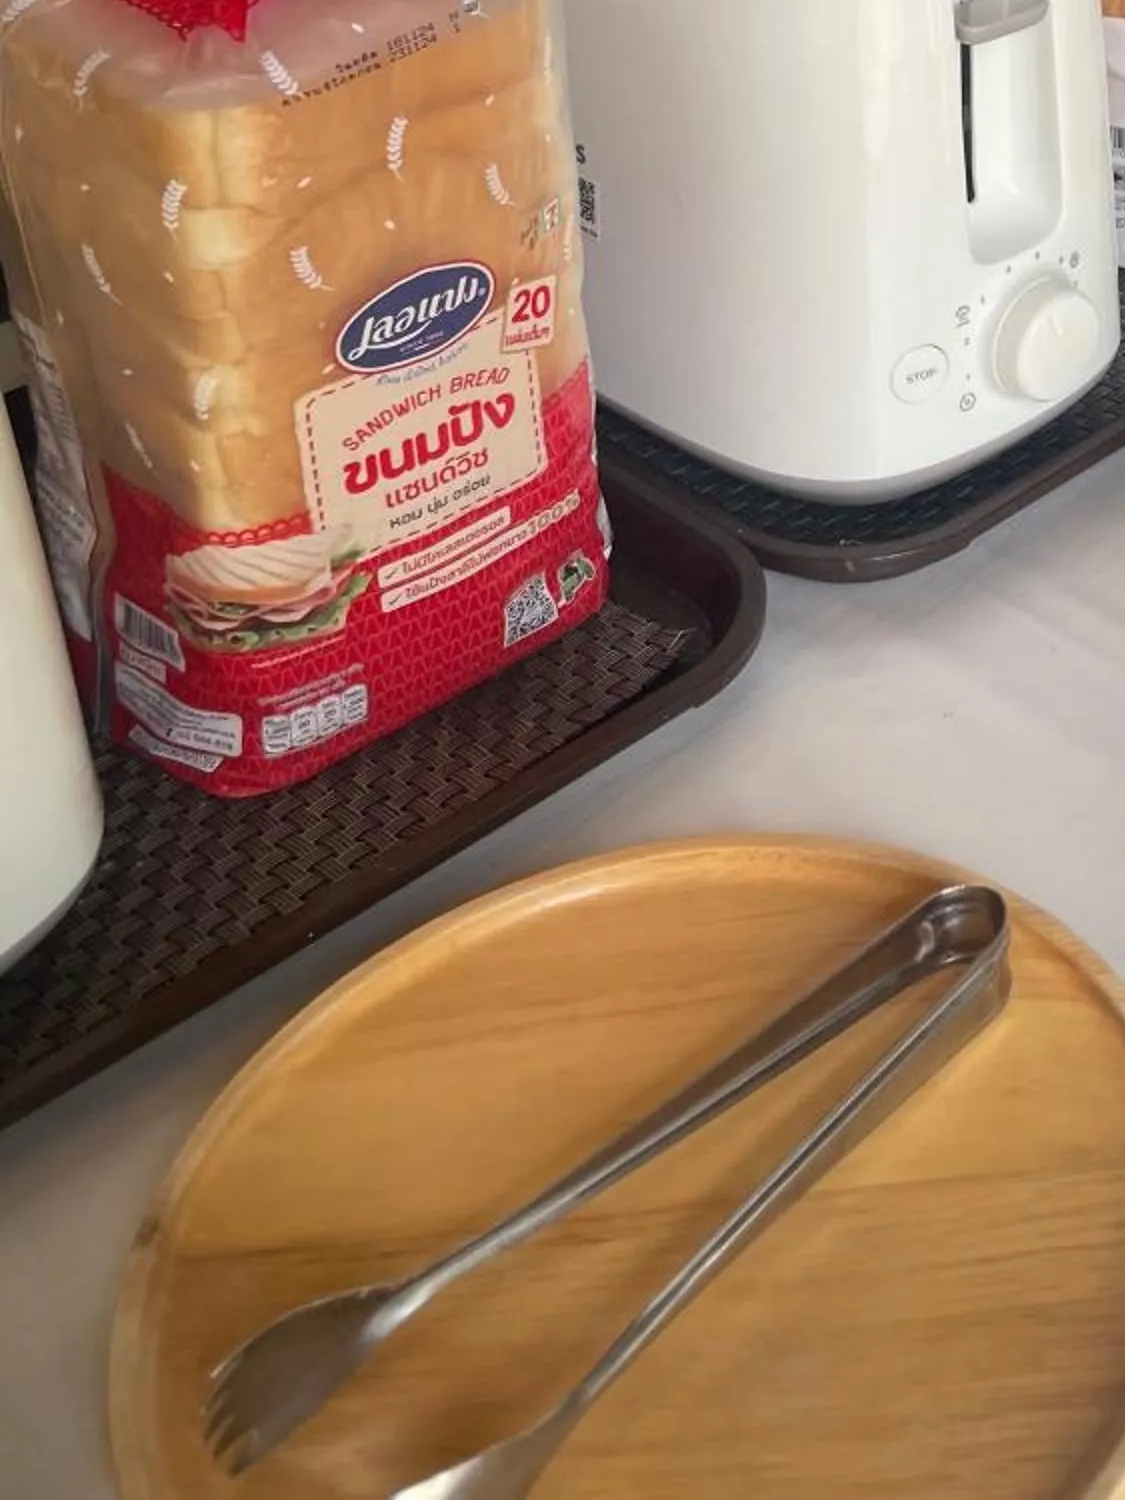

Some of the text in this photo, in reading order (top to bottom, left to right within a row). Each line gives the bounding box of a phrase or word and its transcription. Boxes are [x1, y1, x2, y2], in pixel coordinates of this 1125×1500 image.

[511, 285, 552, 323] 20
[342, 367, 510, 451] SANDWICH BREAD
[344, 393, 515, 494] ขนมปัง
[386, 447, 488, 508] แซนด์วิช
[389, 509, 423, 529] หอม
